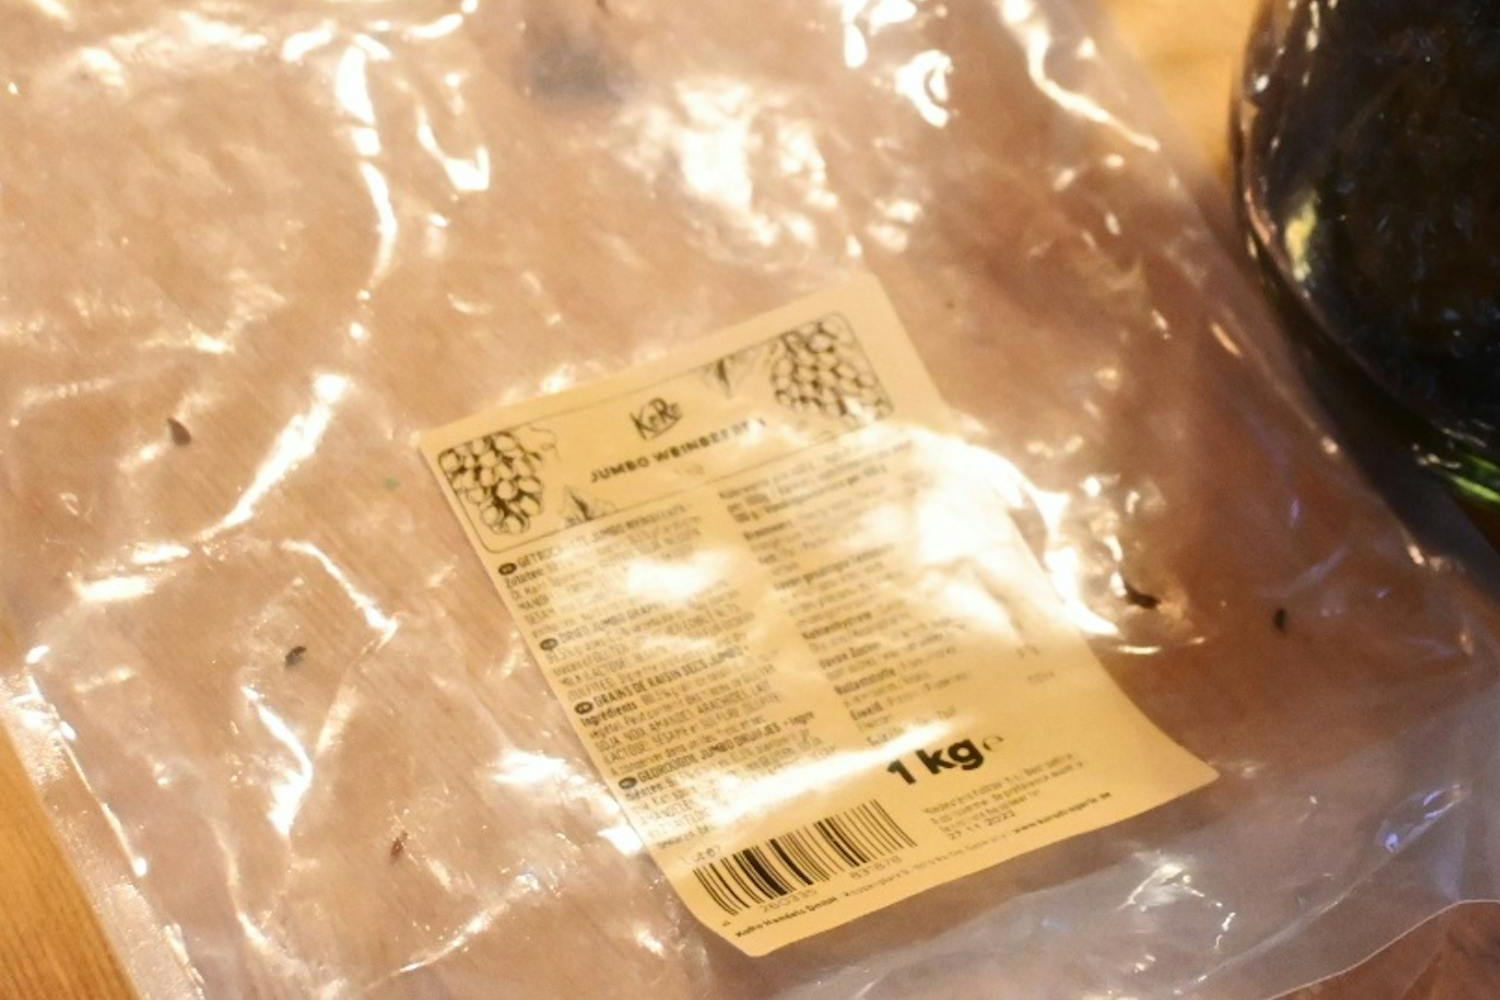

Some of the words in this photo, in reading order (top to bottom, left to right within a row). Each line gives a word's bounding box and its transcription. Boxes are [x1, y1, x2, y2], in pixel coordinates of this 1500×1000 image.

[590, 456, 649, 483] JUMBO
[652, 417, 766, 462] WEINBEERE
[886, 759, 916, 785] 1
[914, 738, 984, 774] kg
